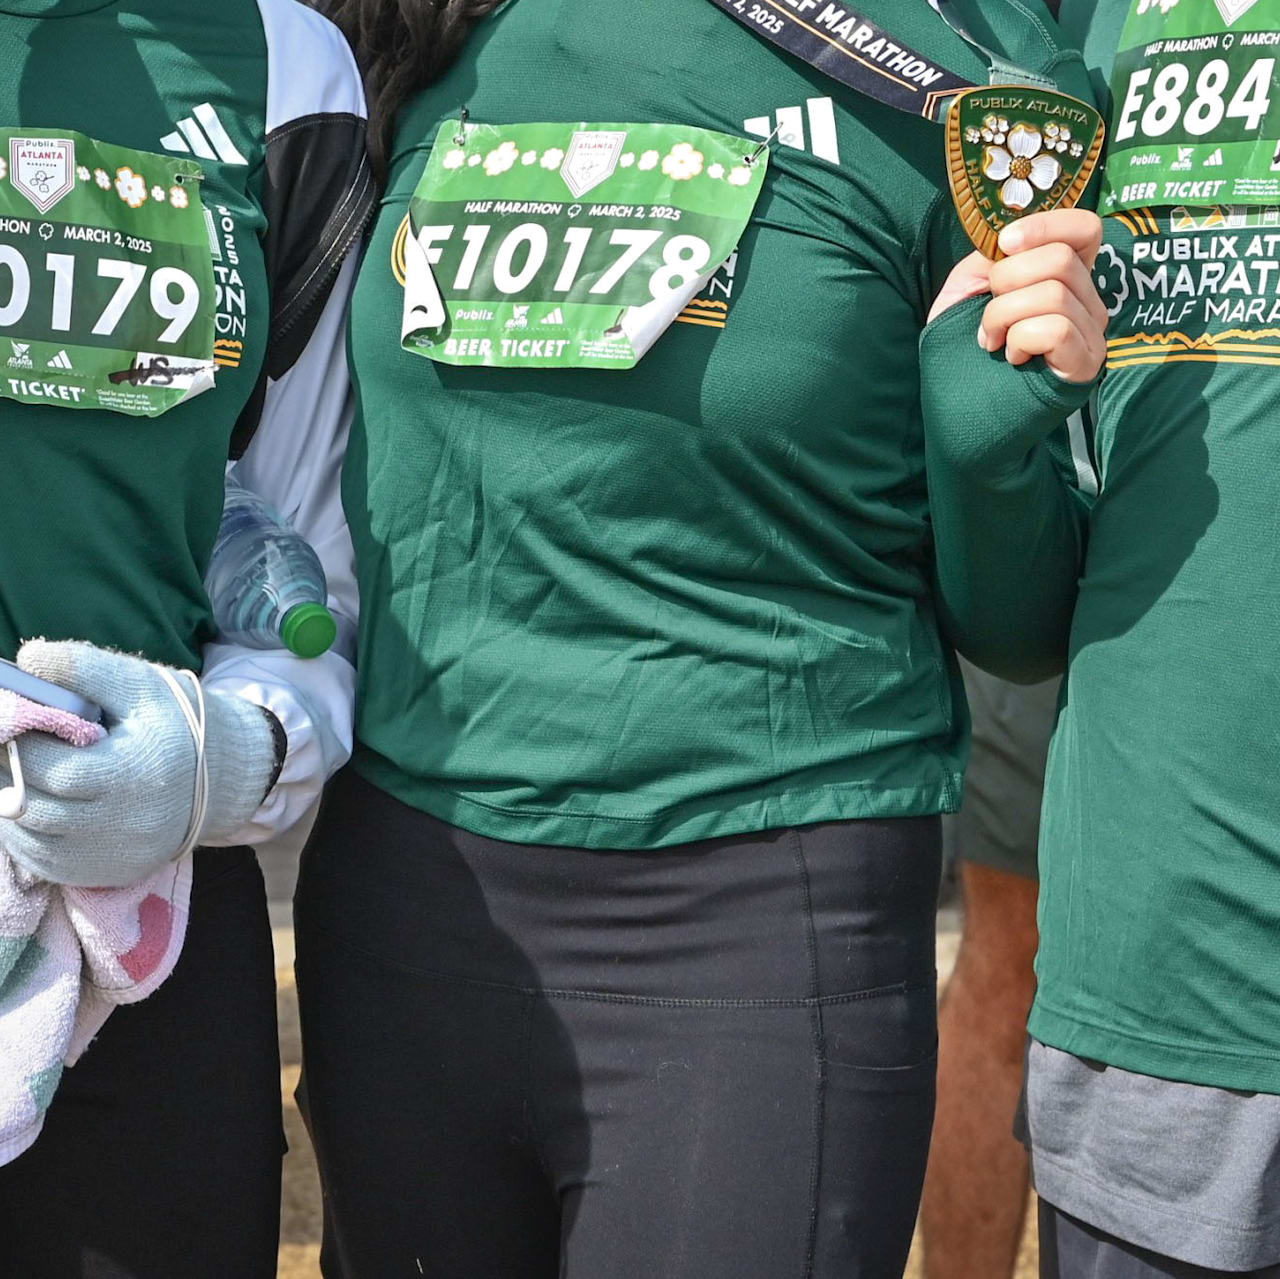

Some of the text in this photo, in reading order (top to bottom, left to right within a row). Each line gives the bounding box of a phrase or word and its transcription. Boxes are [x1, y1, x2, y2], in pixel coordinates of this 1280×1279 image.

[747, 4, 785, 34] 2025
[816, 2, 944, 87] MARATHON
[1144, 42, 1163, 57] HALF
[1163, 36, 1218, 53] MARATHON
[1240, 32, 1280, 45] MARCH
[970, 96, 1089, 126] PUBLIX ATLANTA
[21, 150, 64, 160] ATLANTA
[966, 158, 992, 214] HALF
[1121, 182, 1158, 203] BEER
[464, 202, 681, 220] HALF MARATHON MARCH 2, 2025
[63, 226, 111, 244] MARCH
[114, 232, 125, 248] 2,
[126, 236, 152, 254] 2025
[216, 204, 239, 266] 2025
[421, 223, 711, 302] F10178
[1133, 235, 1238, 264] PUBLIX
[1132, 300, 1197, 326] HALF
[444, 338, 492, 357] BEER
